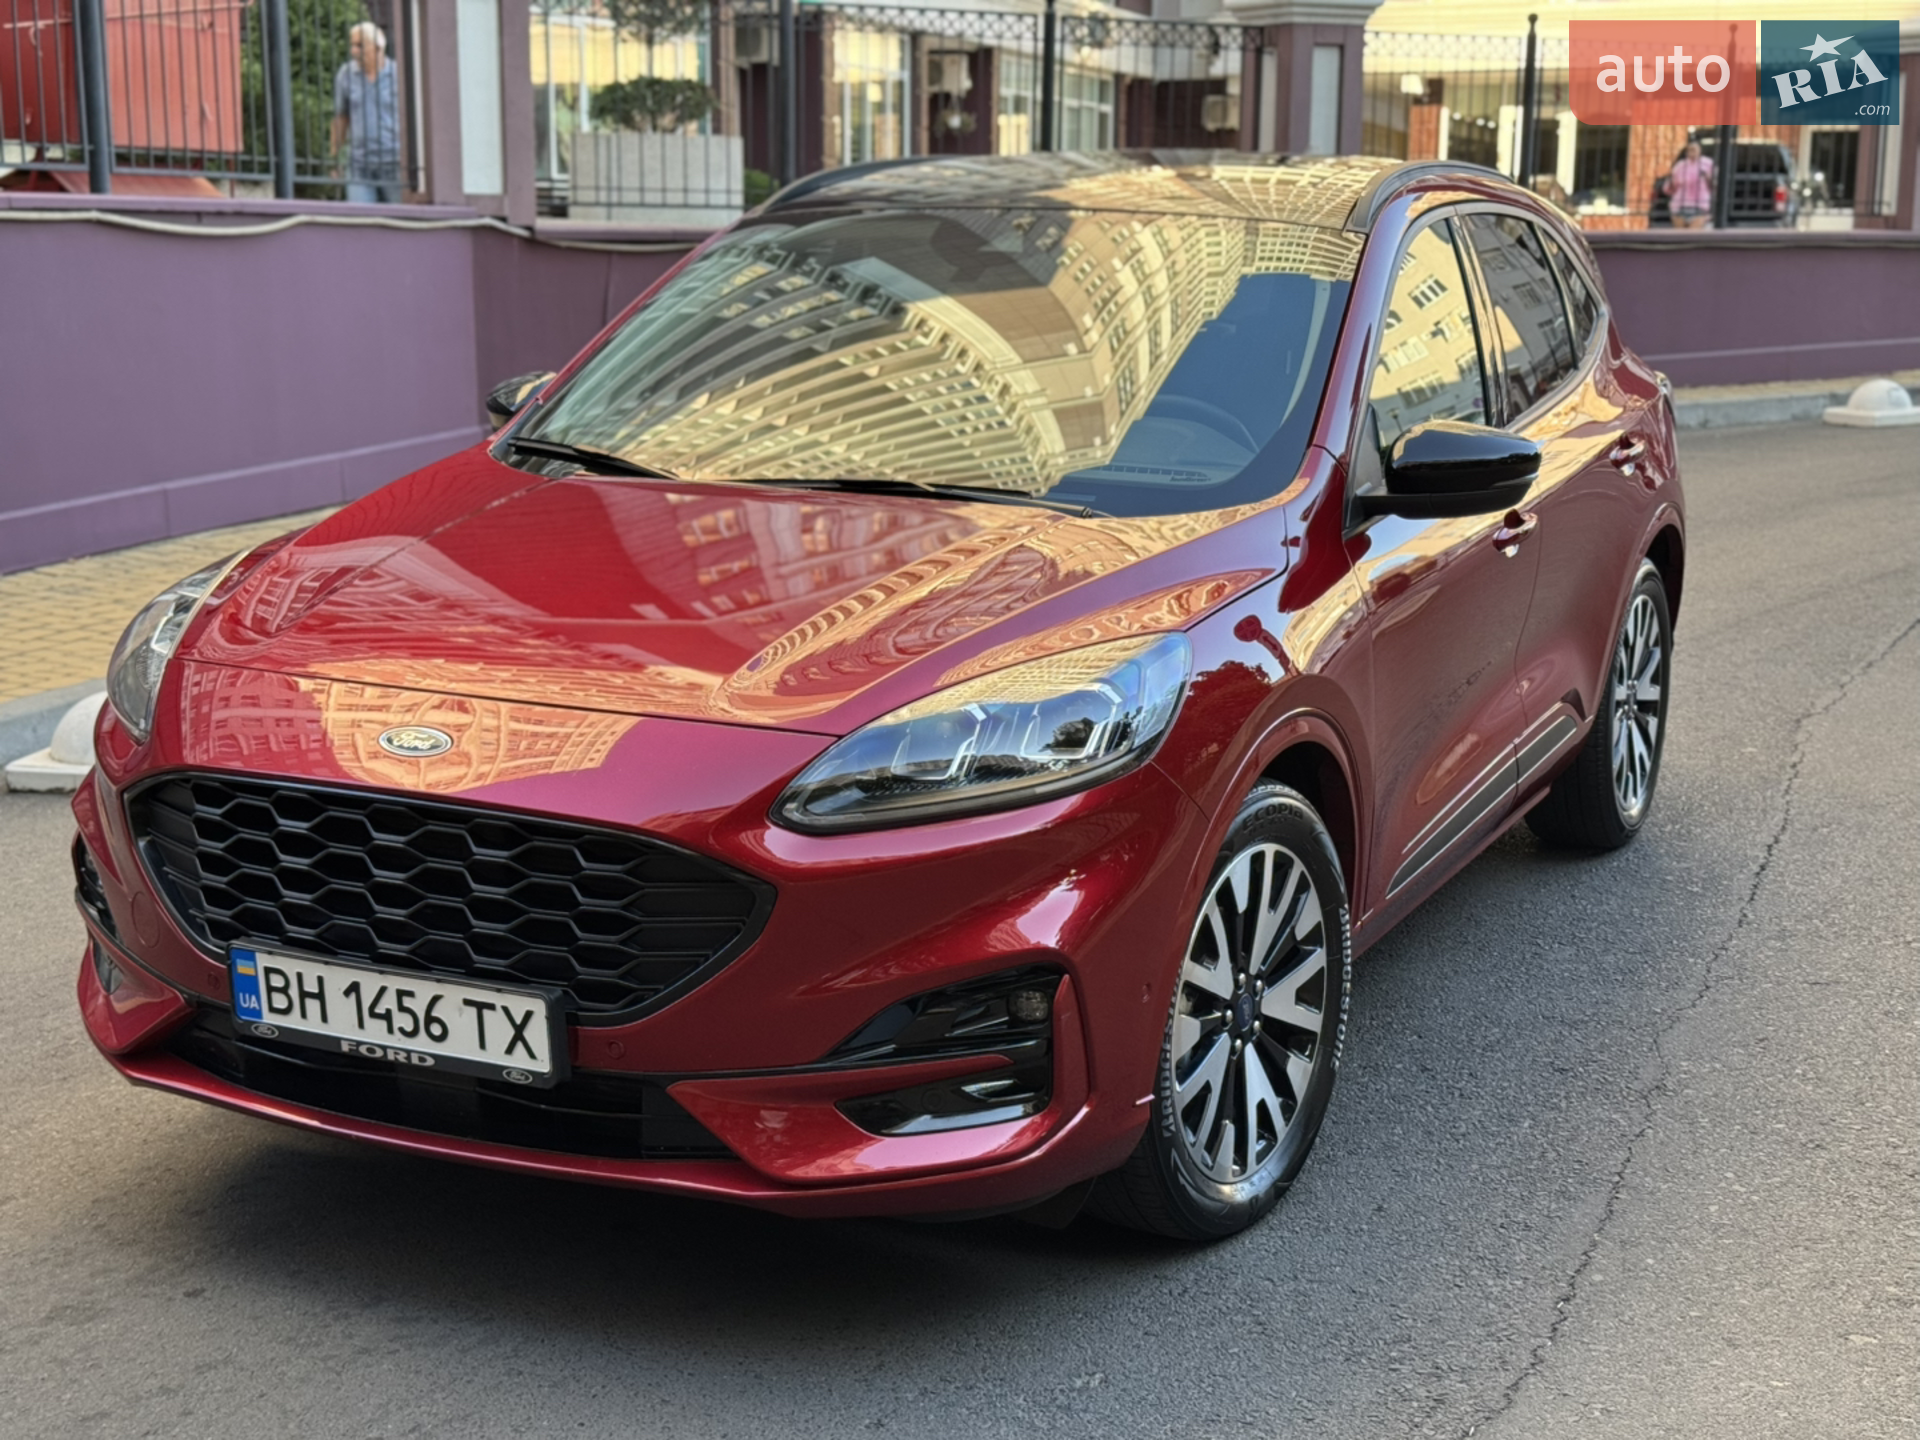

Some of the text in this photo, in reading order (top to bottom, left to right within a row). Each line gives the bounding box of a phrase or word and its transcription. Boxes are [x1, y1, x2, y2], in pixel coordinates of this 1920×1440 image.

[240, 992, 260, 1011] UA
[263, 965, 538, 1061] BH 1456 TX
[340, 1040, 436, 1067] FORD
